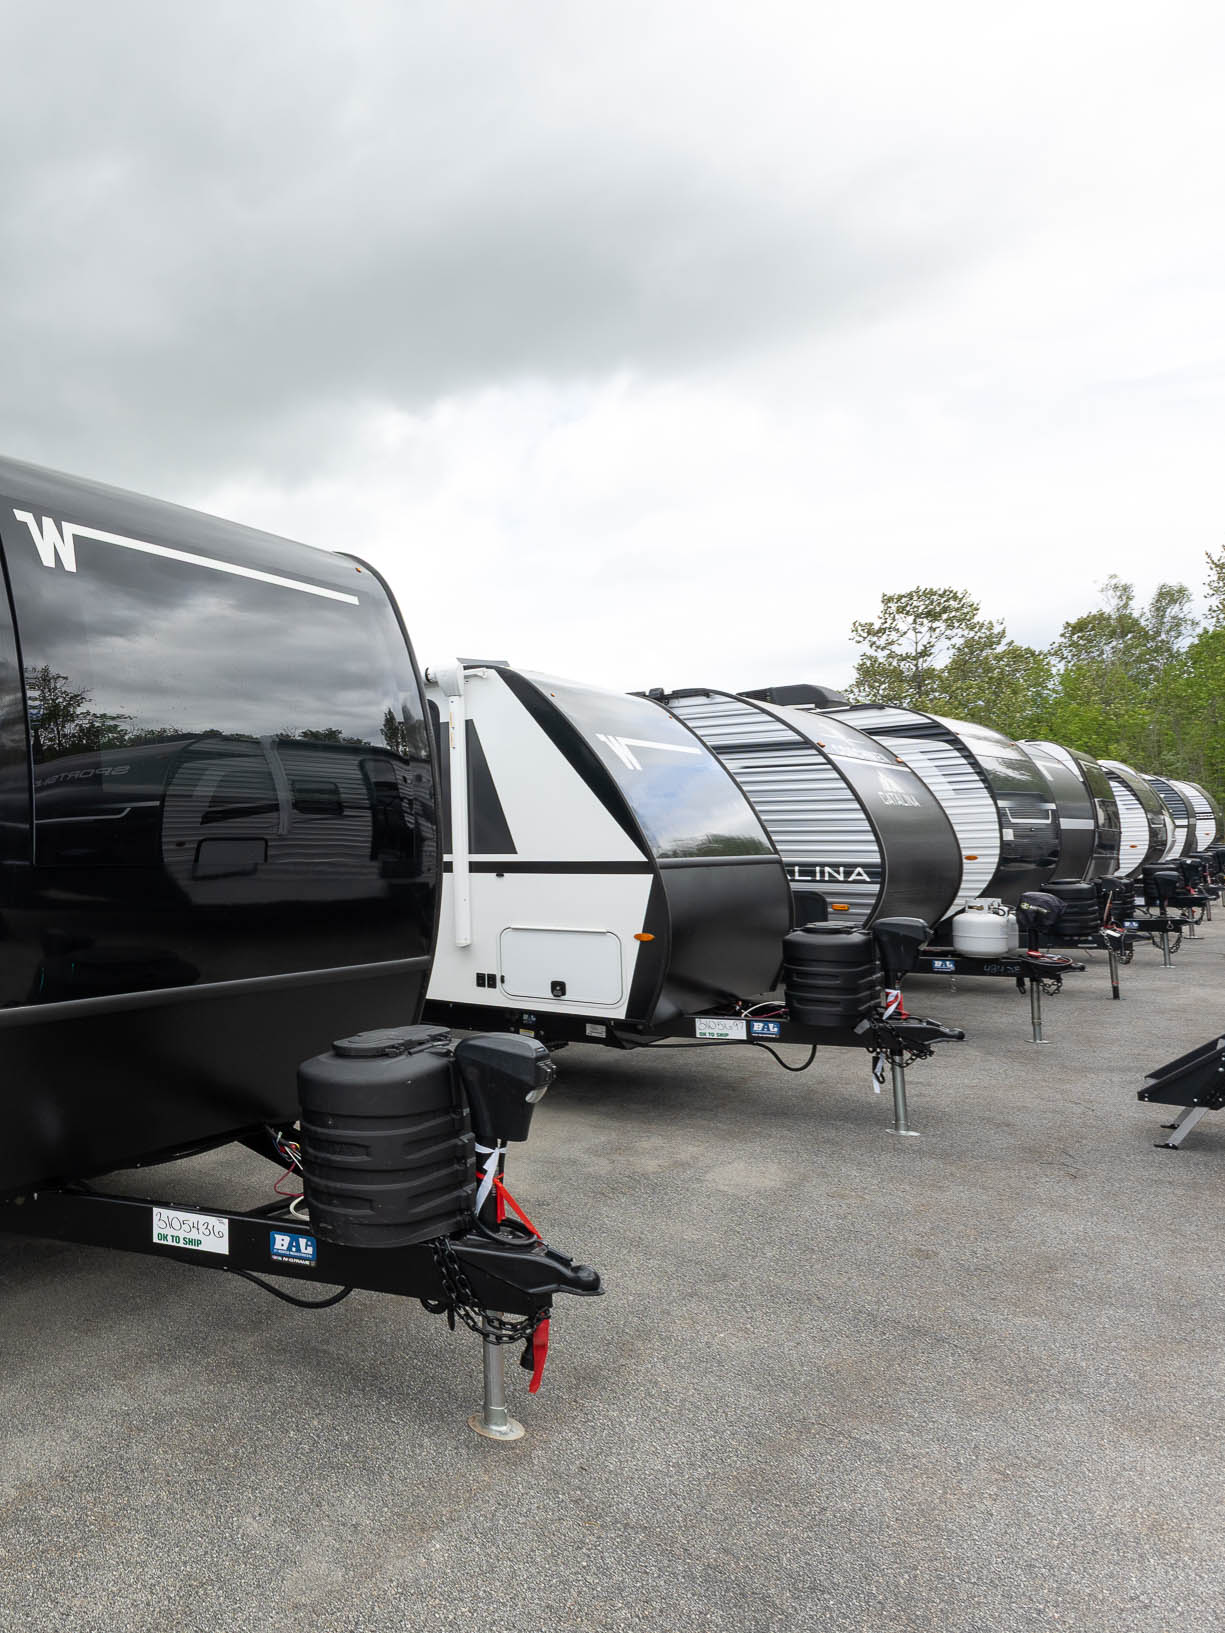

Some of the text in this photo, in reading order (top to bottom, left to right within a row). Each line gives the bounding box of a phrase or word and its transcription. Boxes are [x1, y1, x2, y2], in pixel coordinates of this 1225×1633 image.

[786, 866, 872, 882] LINA
[753, 1022, 779, 1033] BAL
[155, 1211, 225, 1239] 3105436
[157, 1232, 202, 1248] OK TO SHIP
[274, 1234, 313, 1255] BAL
